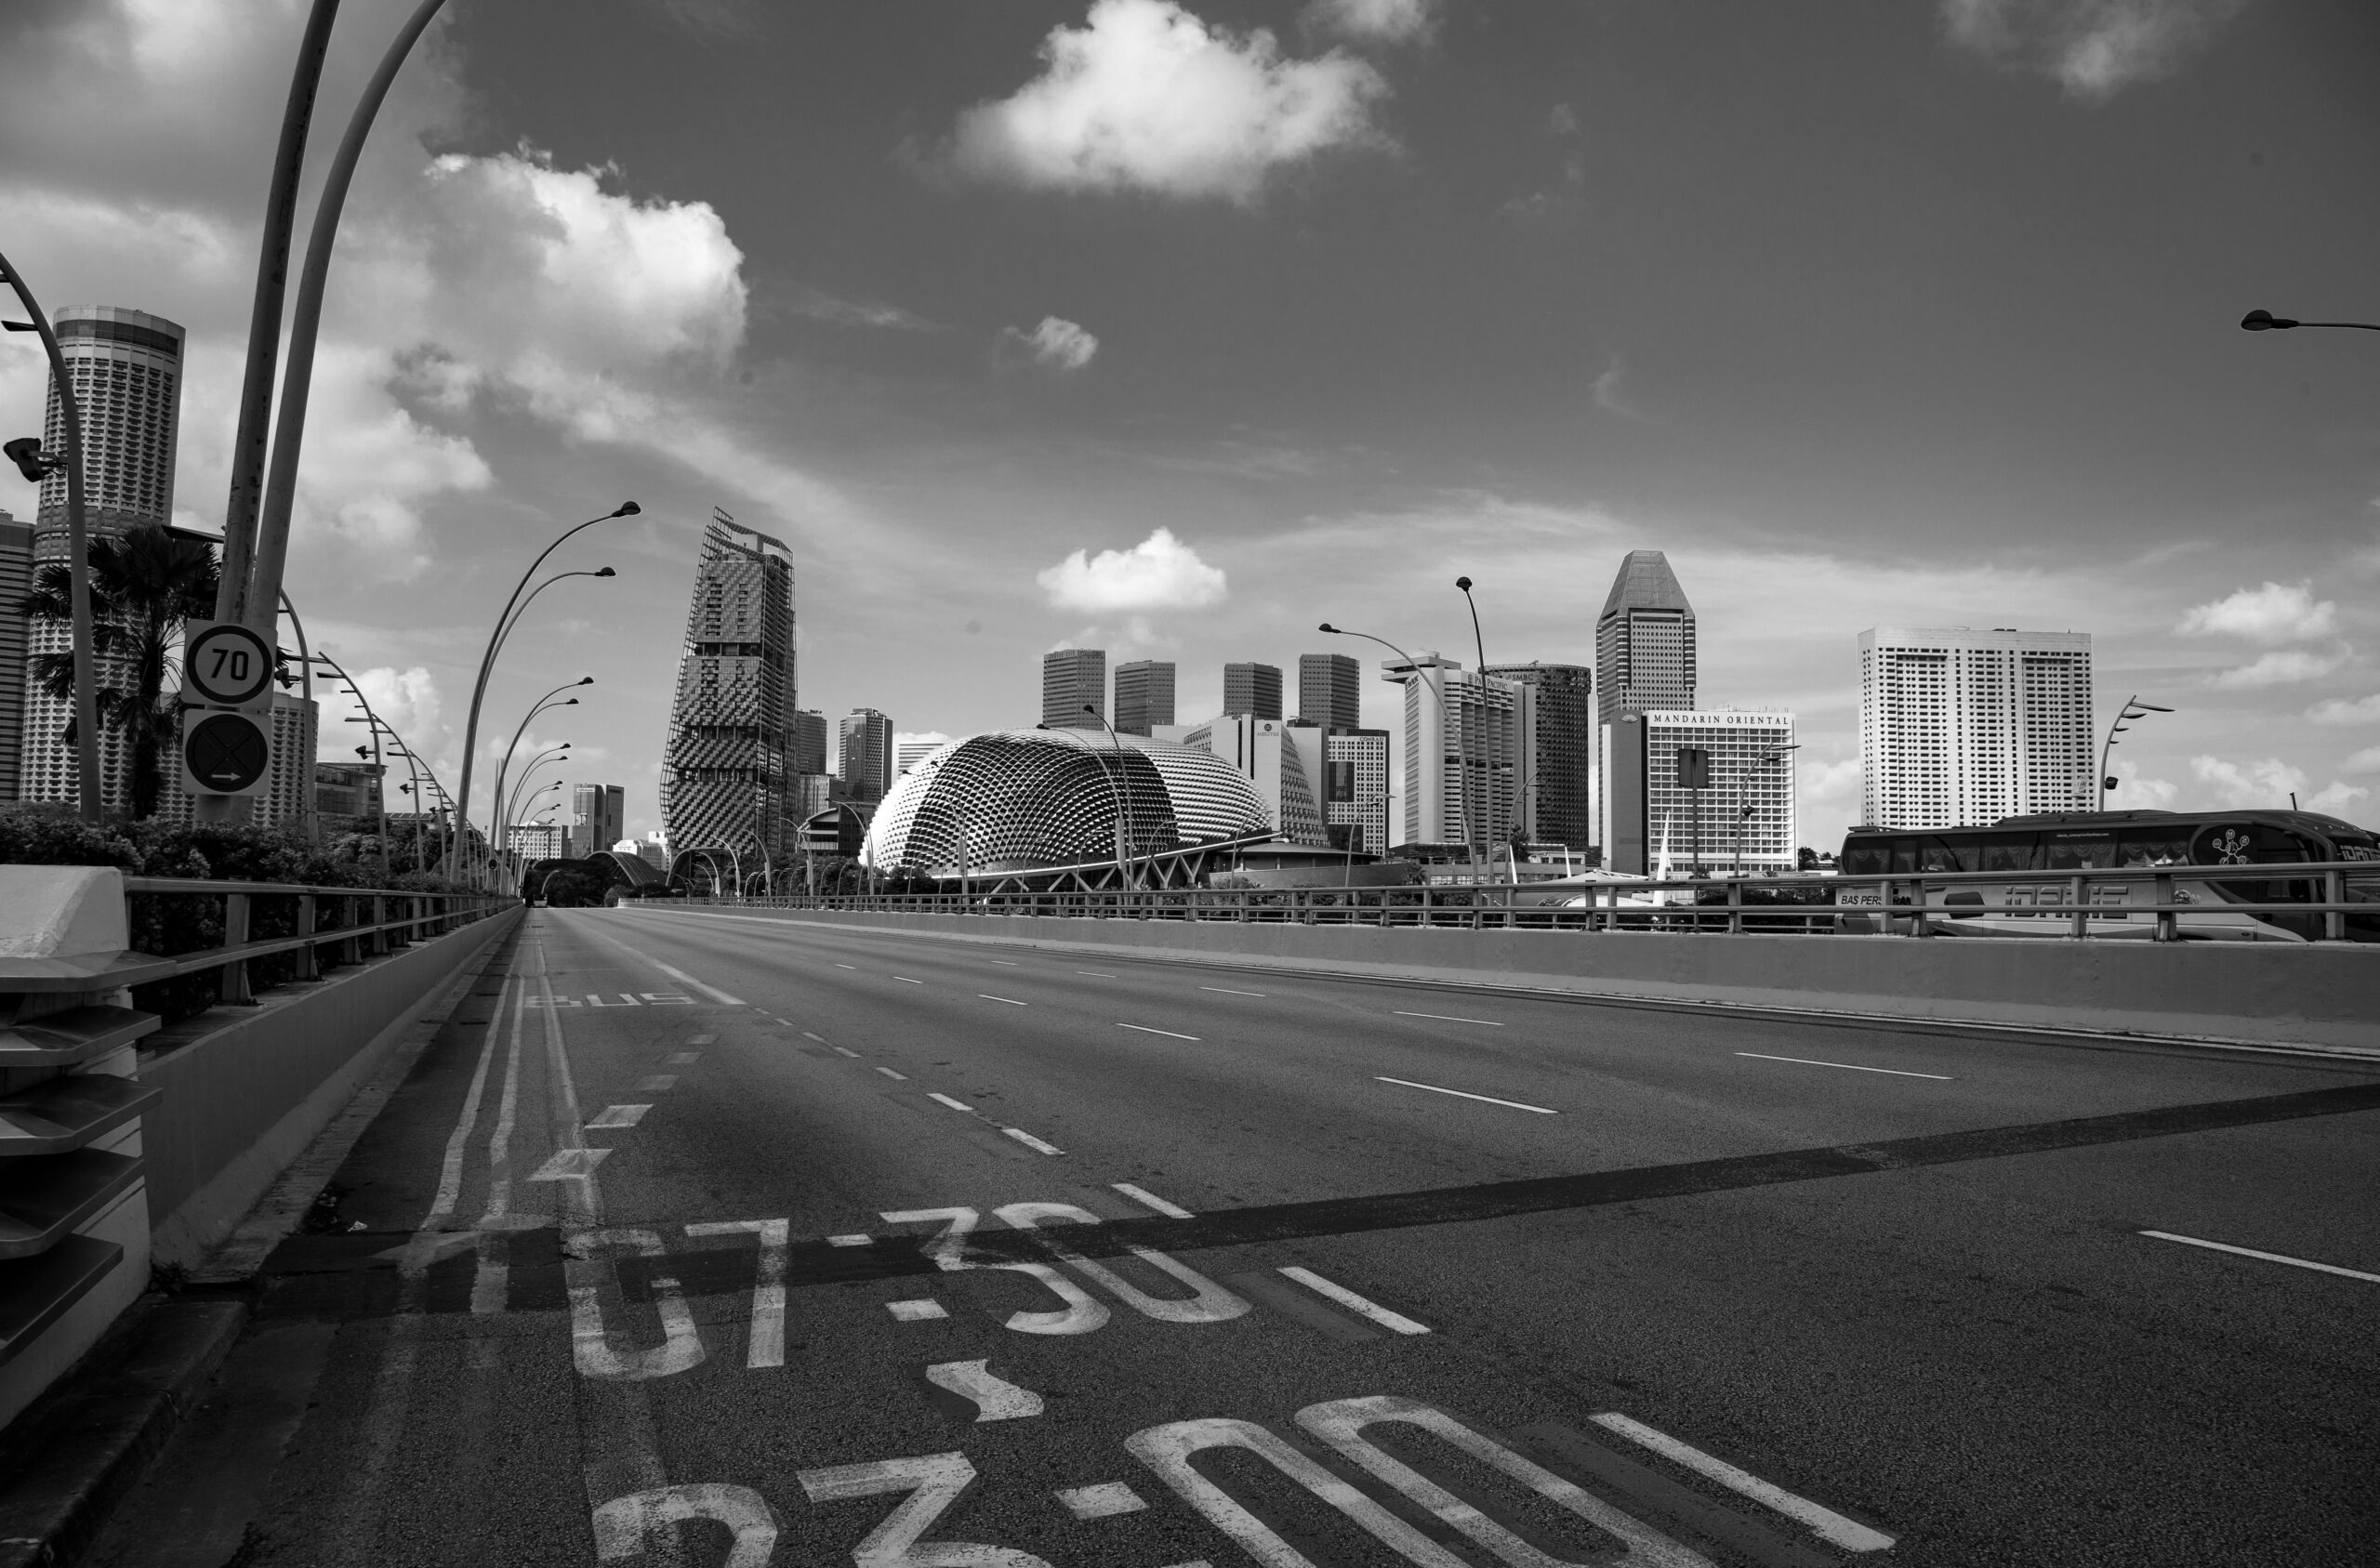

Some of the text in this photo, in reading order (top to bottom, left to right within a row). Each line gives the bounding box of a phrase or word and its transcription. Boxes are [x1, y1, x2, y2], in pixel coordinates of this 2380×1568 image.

[211, 648, 249, 680] 70
[1488, 679, 1508, 690] PACIFIC
[1654, 715, 1789, 725] MANDARIN ORIENTAL
[1841, 895, 1859, 905] BAS
[523, 993, 698, 1008] BUS
